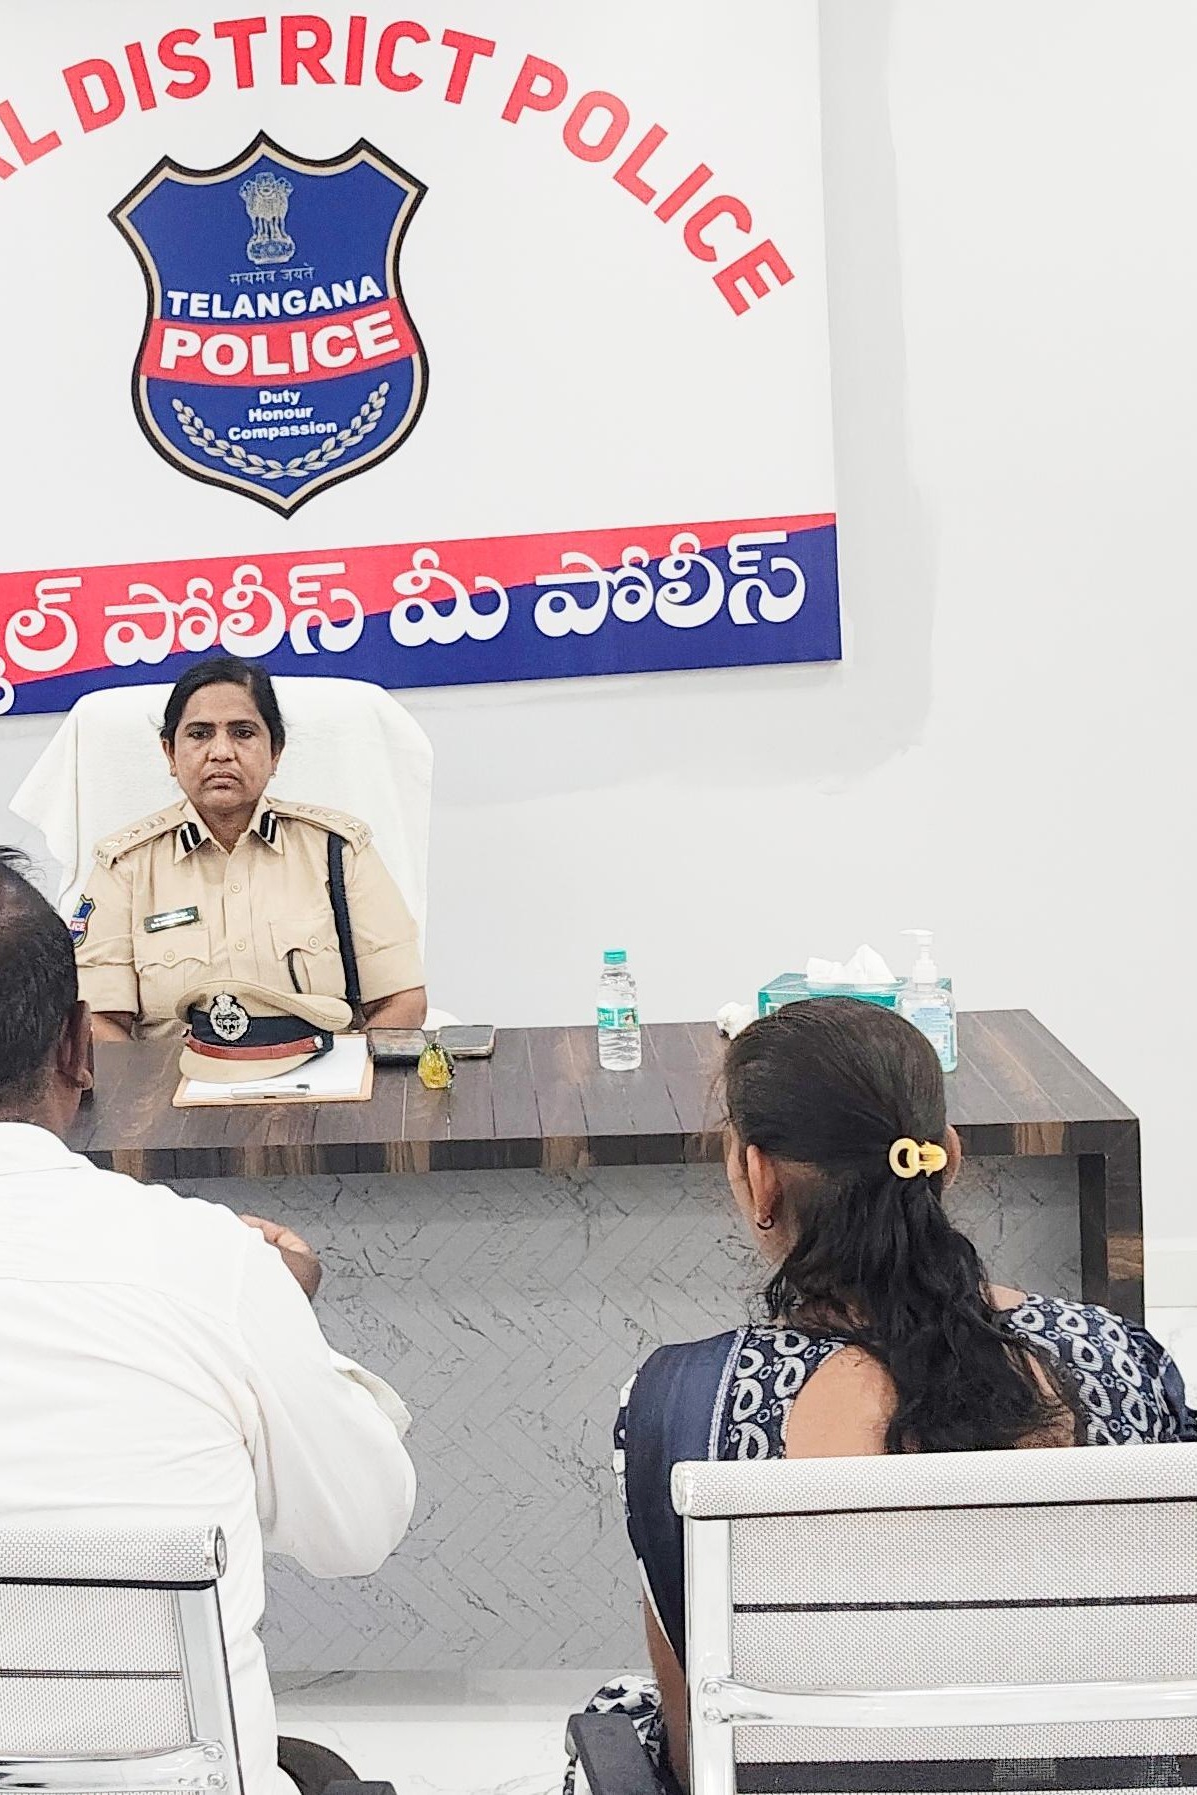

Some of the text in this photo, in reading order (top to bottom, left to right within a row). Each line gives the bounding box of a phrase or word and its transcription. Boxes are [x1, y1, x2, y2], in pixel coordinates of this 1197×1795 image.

[62, 15, 496, 134] DISTRICT
[501, 54, 795, 316] POLICE
[167, 275, 383, 319] TELANGANA
[160, 310, 400, 376] POLICE
[248, 406, 314, 422] Honour
[259, 389, 301, 406] Duty
[228, 421, 338, 441] Compassion
[104, 563, 365, 666] పోలీస్
[389, 547, 510, 647] మీ
[534, 530, 806, 638] పోలీస్
